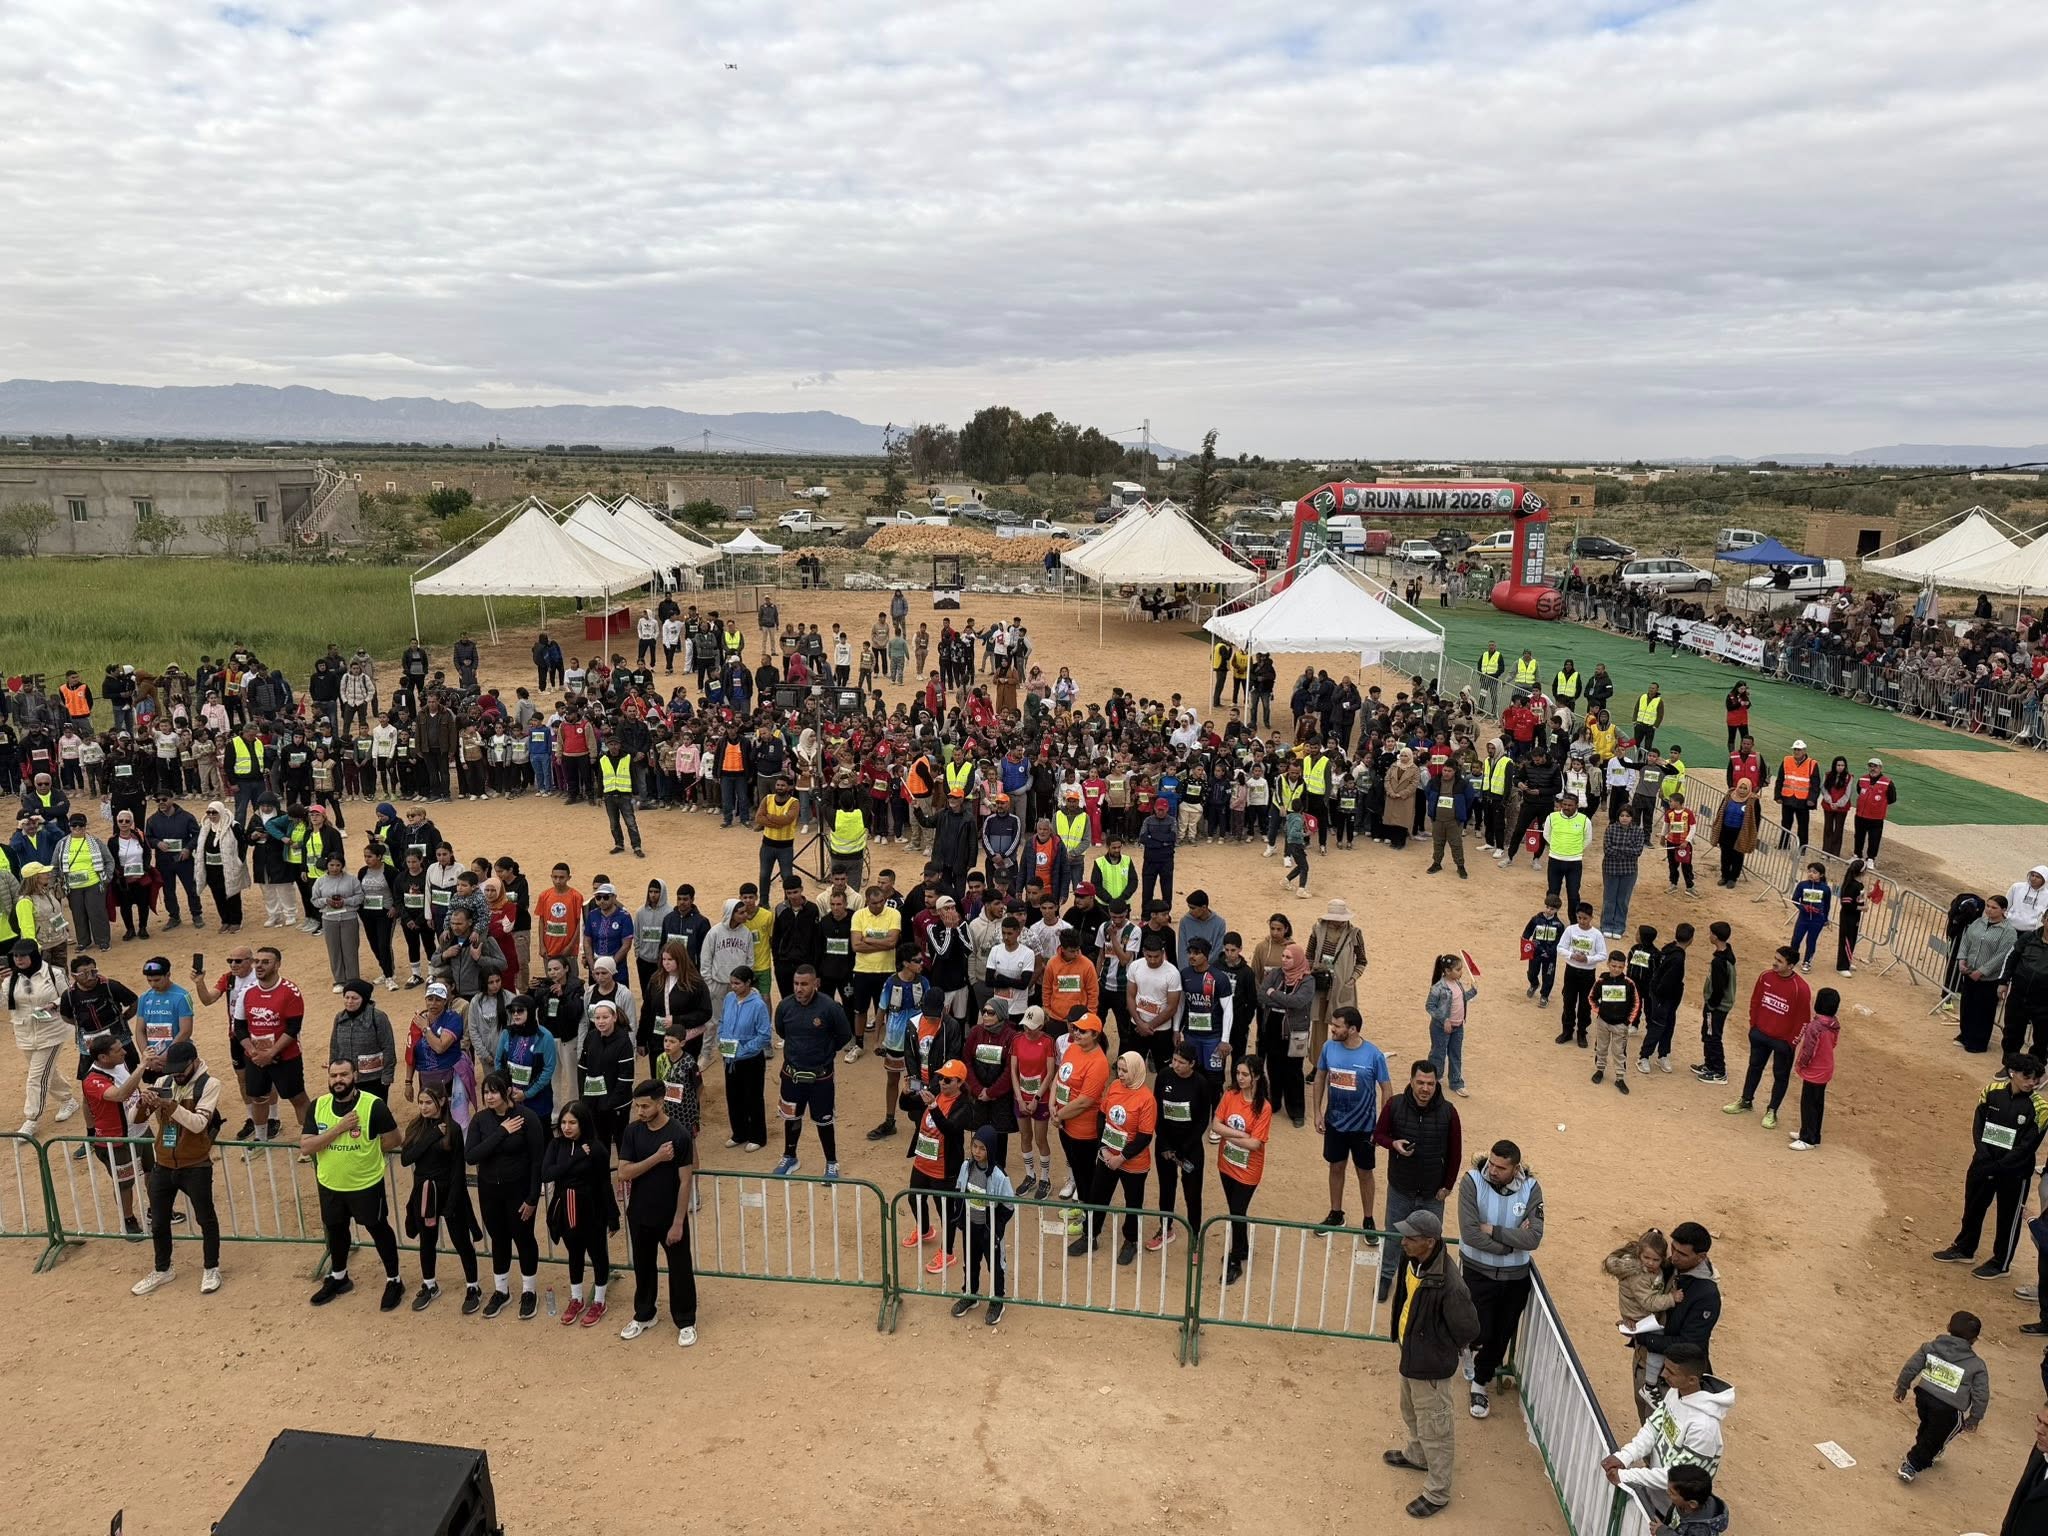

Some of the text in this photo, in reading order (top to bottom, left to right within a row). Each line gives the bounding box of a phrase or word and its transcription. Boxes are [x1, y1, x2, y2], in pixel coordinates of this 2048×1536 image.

[1364, 491, 1492, 509] RUN ALIM 2026
[1186, 992, 1211, 1002] QATAR
